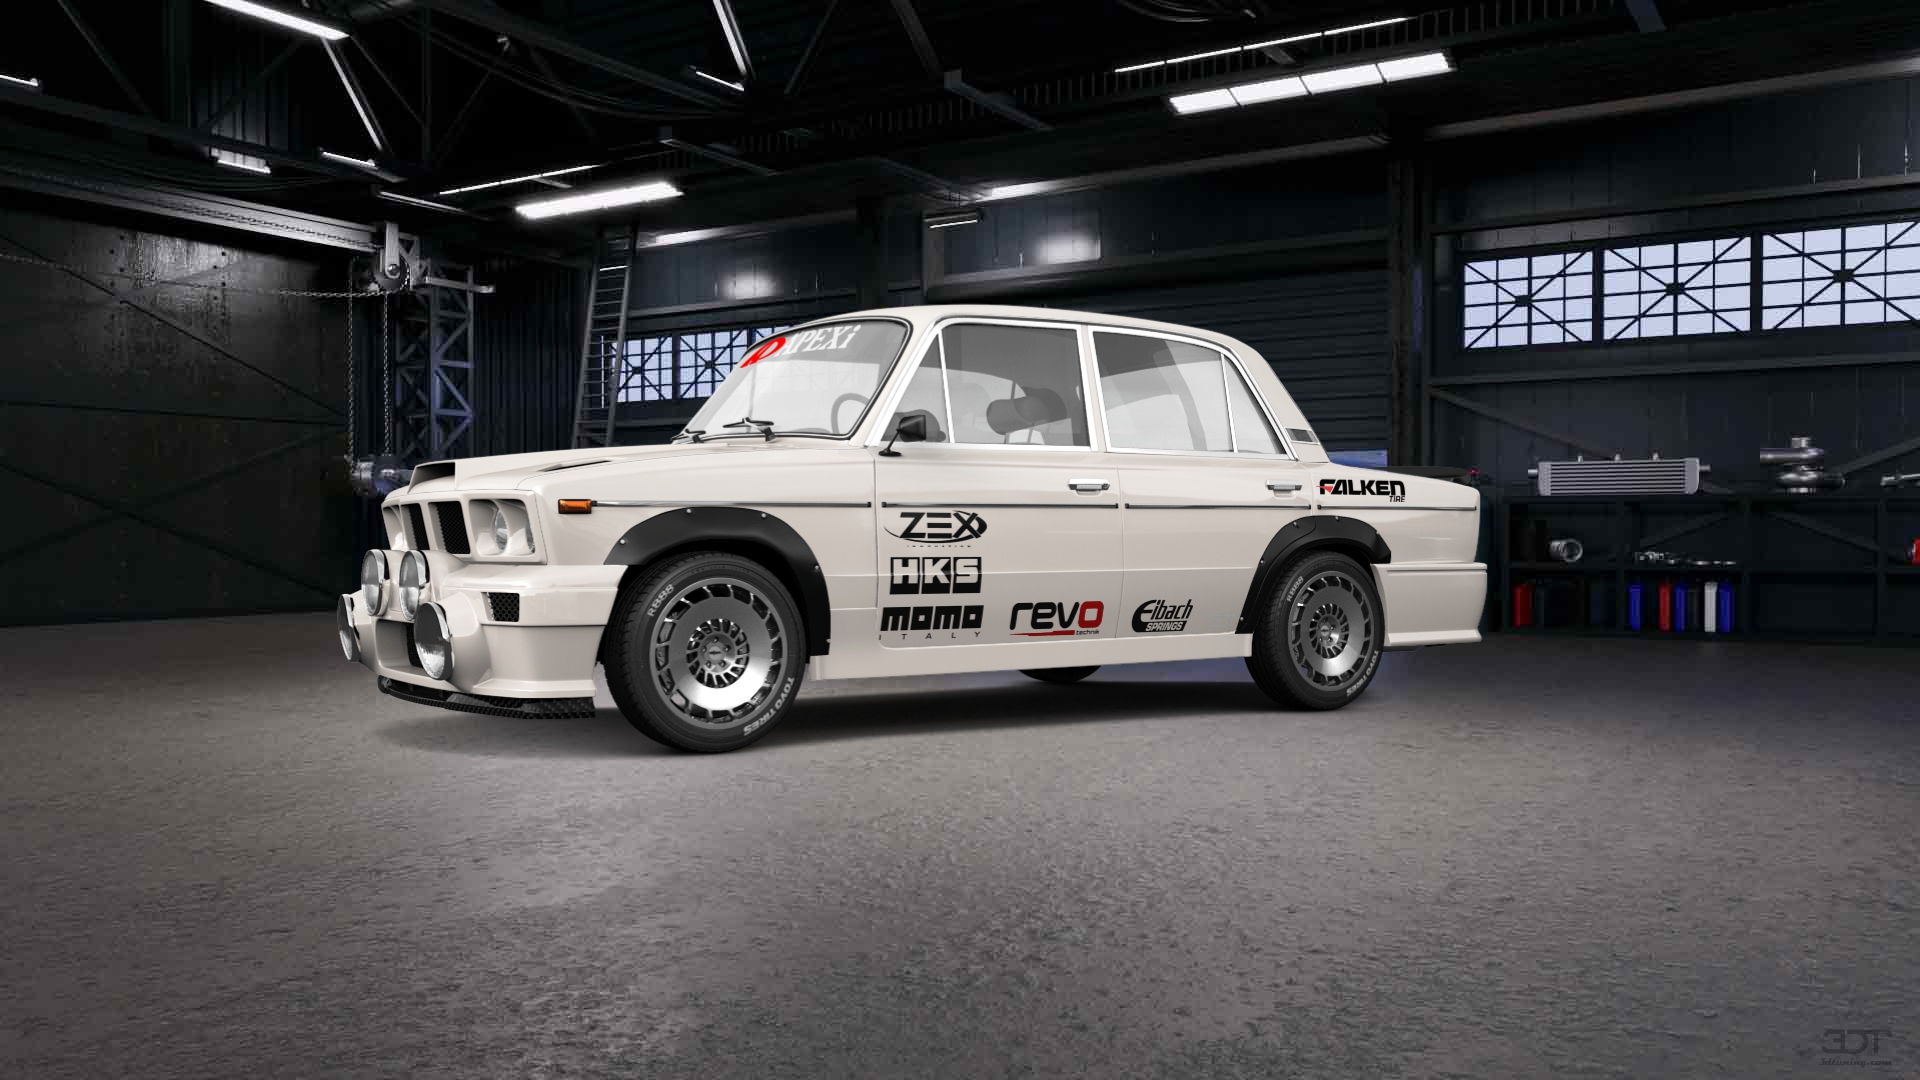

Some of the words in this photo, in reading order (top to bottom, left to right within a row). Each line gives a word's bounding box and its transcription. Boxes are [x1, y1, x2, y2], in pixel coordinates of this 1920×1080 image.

[1317, 479, 1406, 496] FALKEN
[899, 511, 984, 539] ZEX
[890, 557, 981, 591] HKS
[647, 583, 675, 617] R888
[1010, 601, 1104, 629] revo
[1132, 599, 1193, 631] Eibach
[1145, 621, 1184, 632] SPRINGS
[878, 631, 982, 641] ITALY
[1366, 650, 1379, 676] TOYO
[774, 676, 795, 710] TOYO
[1346, 675, 1369, 697] TIRES
[743, 707, 778, 736] TIRES
